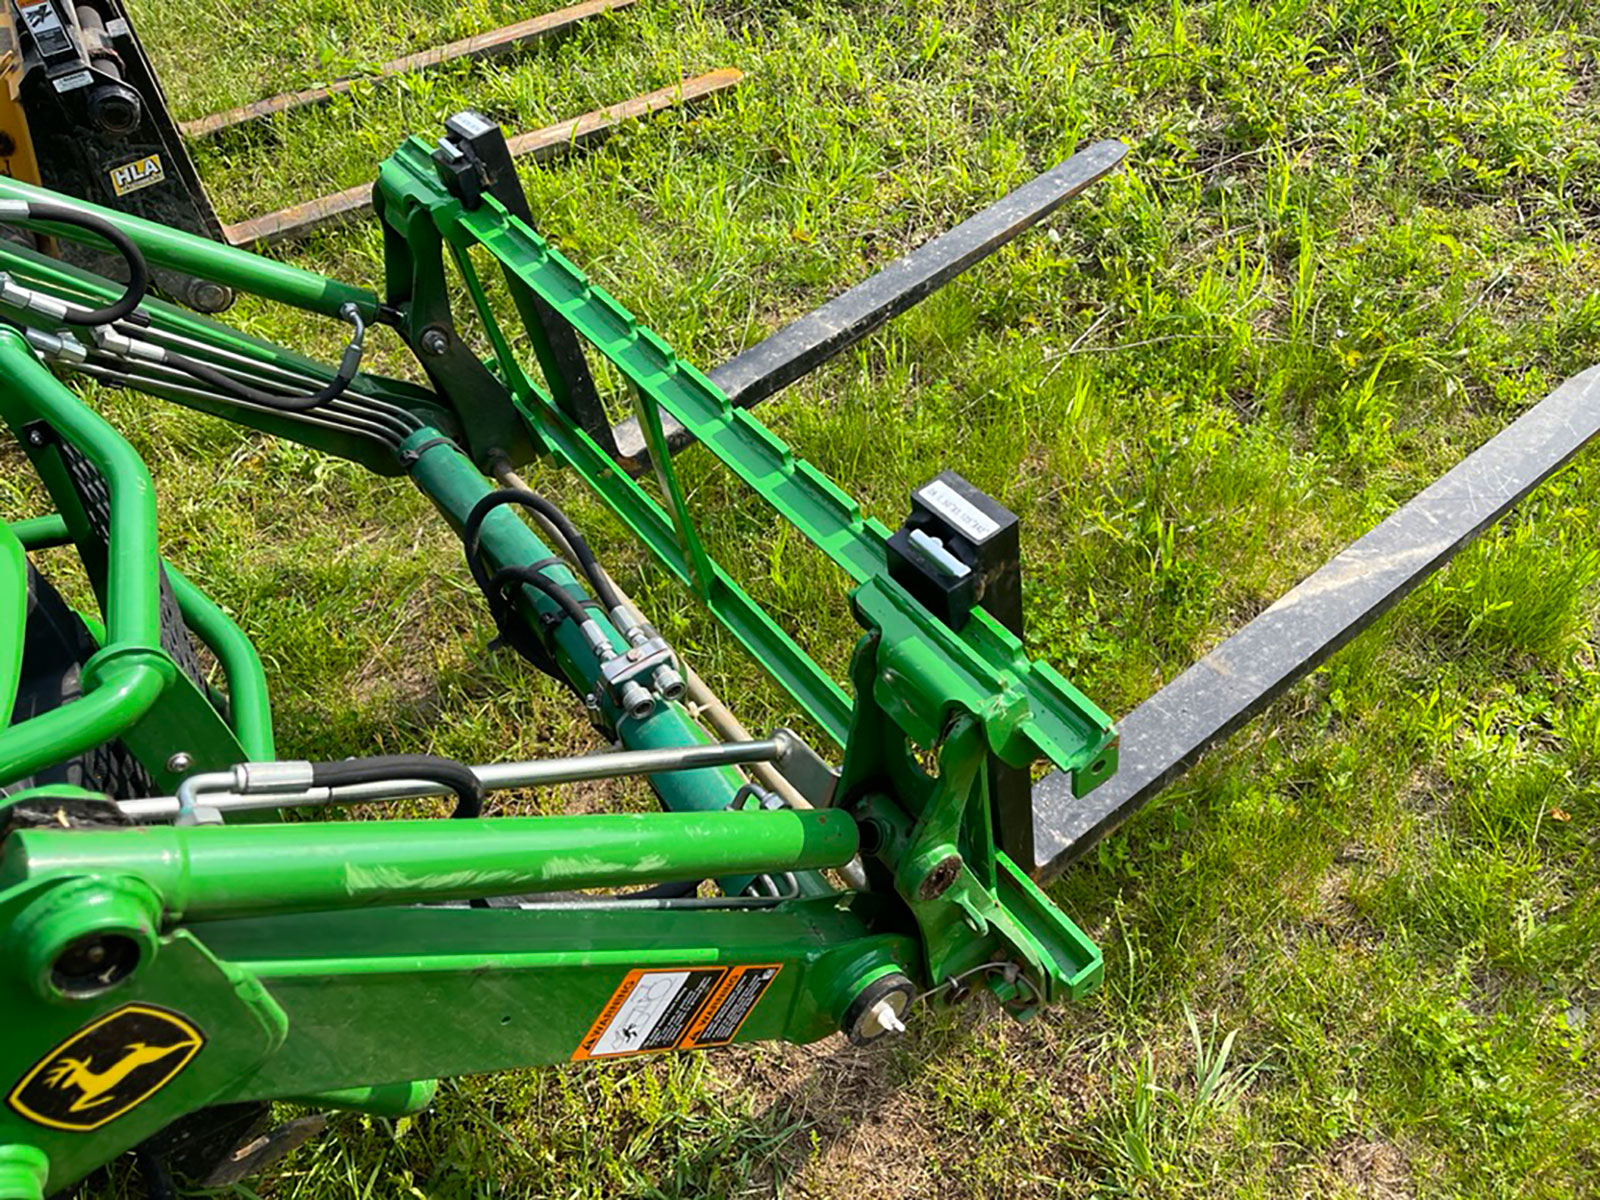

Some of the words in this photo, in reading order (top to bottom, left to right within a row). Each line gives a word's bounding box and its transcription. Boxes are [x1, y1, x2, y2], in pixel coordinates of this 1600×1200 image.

[115, 159, 159, 186] HLA
[591, 980, 635, 1036] WARNING
[698, 974, 739, 1026] WARNING
